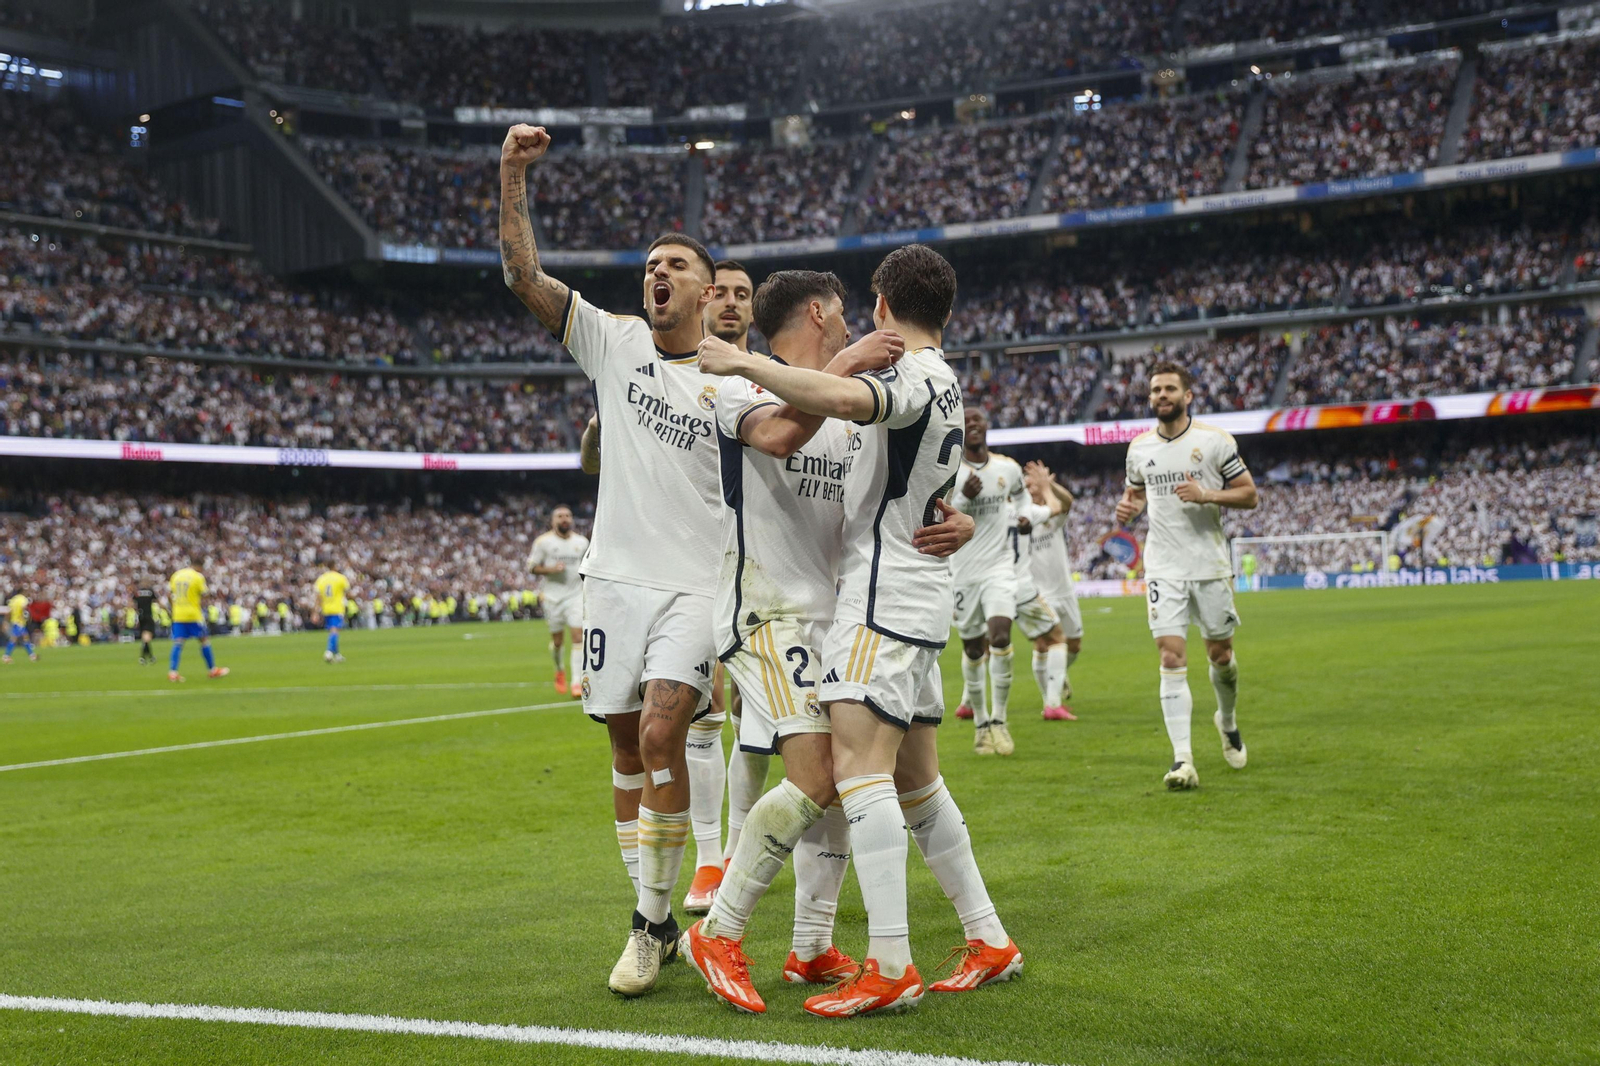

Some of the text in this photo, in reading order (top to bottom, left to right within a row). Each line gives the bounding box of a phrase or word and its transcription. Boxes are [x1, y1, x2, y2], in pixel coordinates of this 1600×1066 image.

[628, 382, 713, 437] Emirates
[798, 478, 821, 498] FLY
[1450, 564, 1500, 583] labs
[1148, 581, 1159, 604] 6
[582, 628, 606, 672] 19
[785, 646, 816, 688] 2
